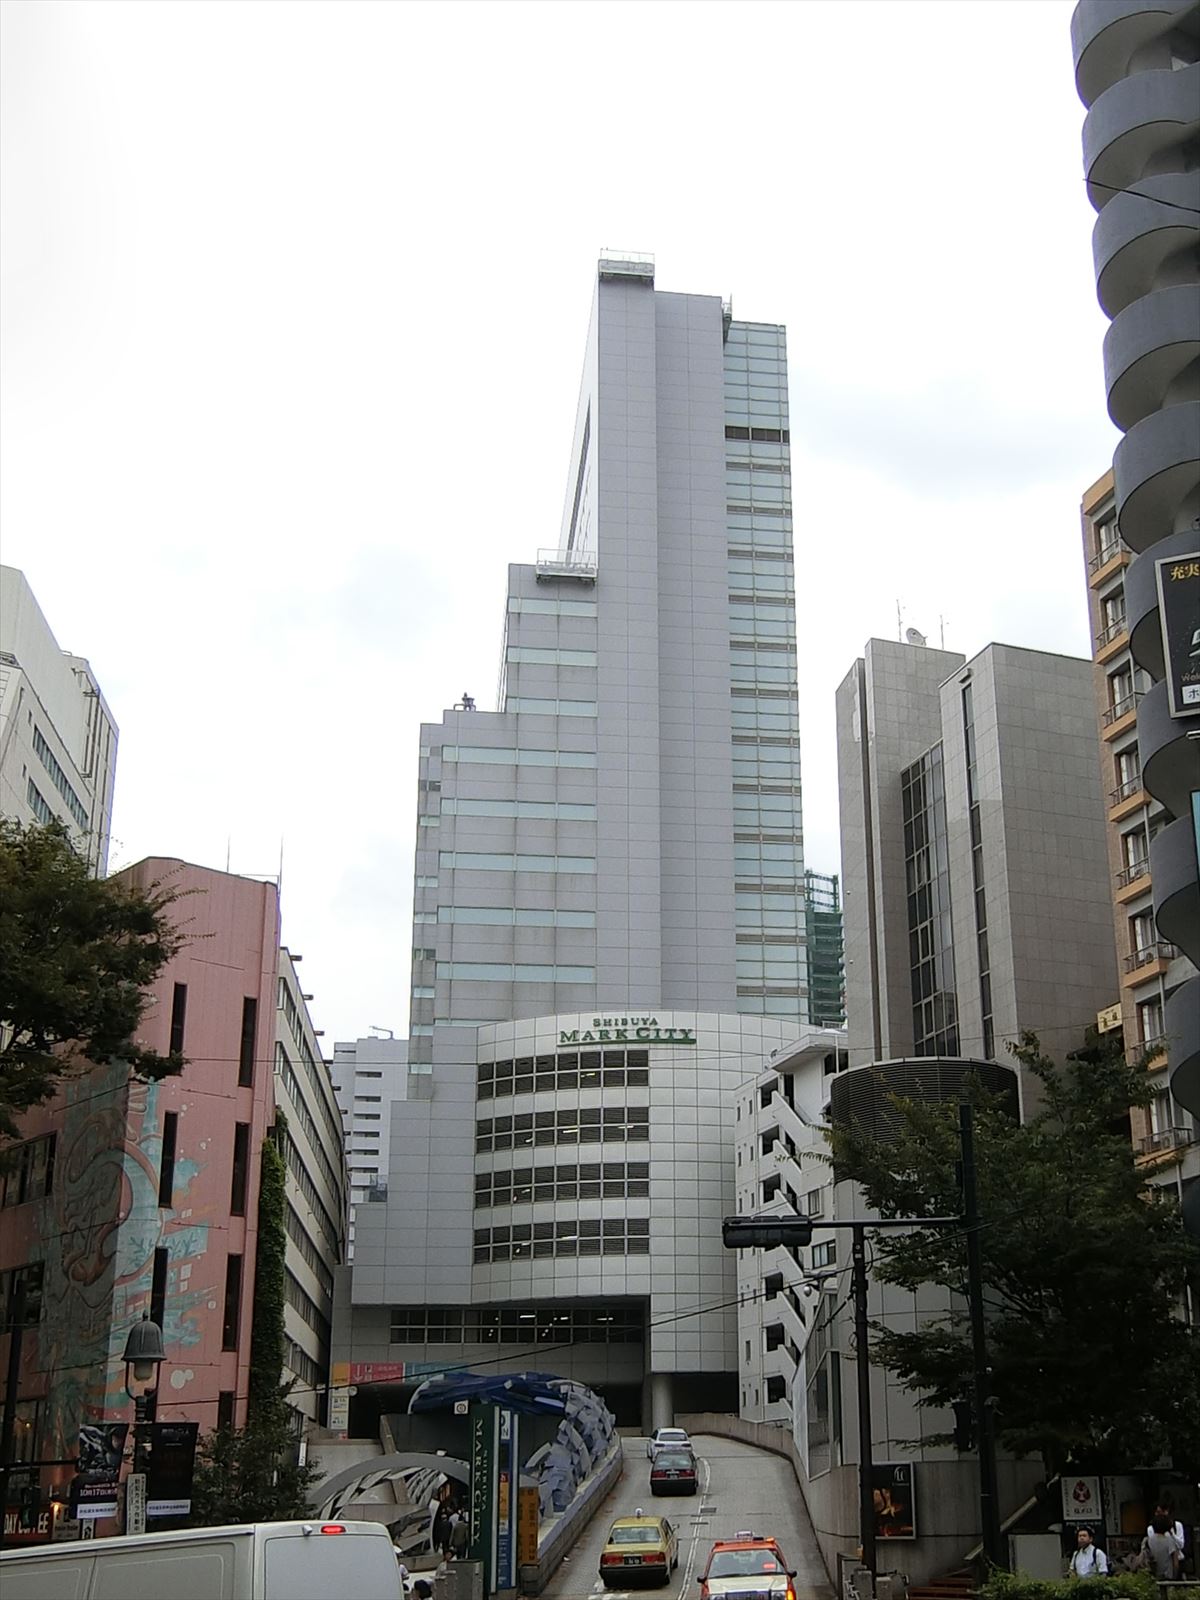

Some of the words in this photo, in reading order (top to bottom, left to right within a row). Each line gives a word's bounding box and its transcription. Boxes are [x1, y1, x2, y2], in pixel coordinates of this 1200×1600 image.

[559, 1029, 628, 1043] MARK
[636, 1027, 693, 1040] CITY
[593, 1018, 658, 1027] SHIBUYA
[475, 1419, 483, 1483] MARK
[473, 1491, 482, 1542] CITY
